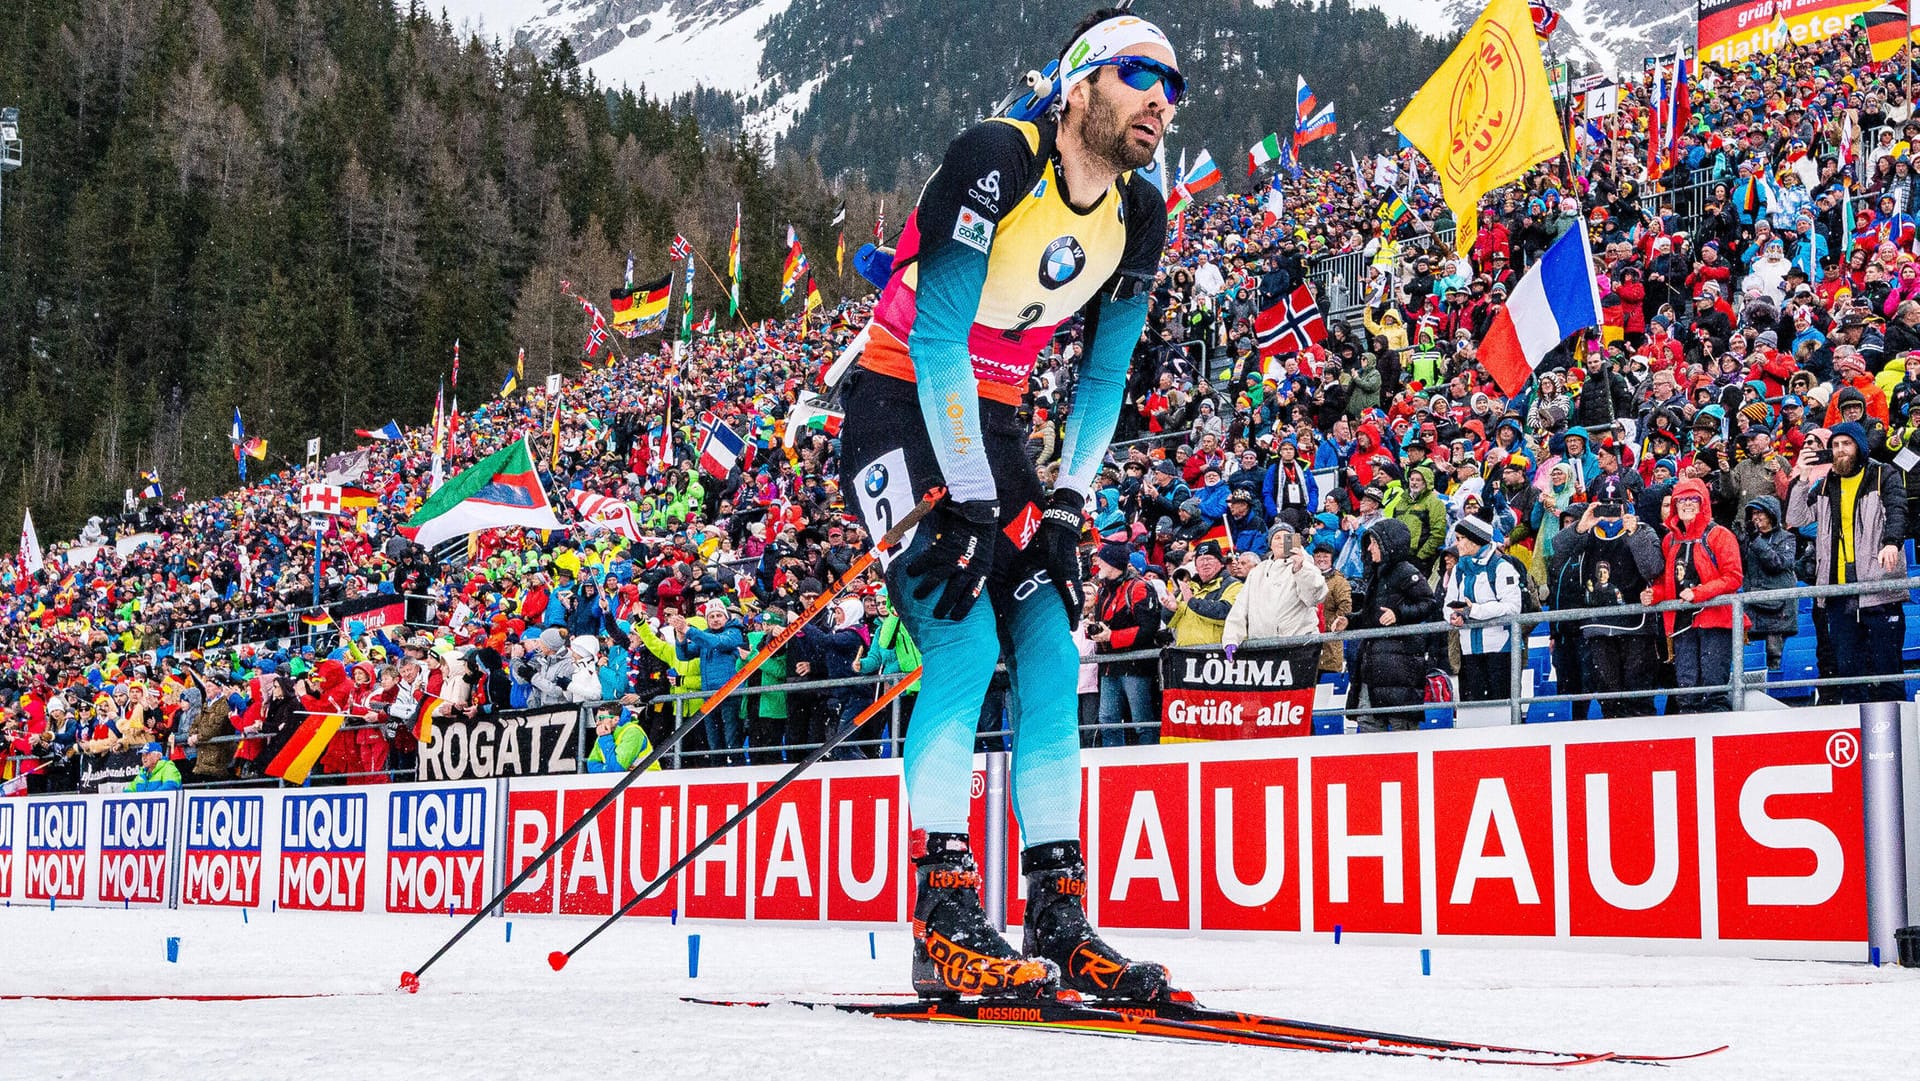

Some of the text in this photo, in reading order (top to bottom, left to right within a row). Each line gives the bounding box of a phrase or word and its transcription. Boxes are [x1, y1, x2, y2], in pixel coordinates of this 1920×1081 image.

[1594, 91, 1607, 111] 4
[968, 188, 999, 214] odlo
[1000, 302, 1046, 343] 2
[945, 392, 974, 455] somfy
[875, 497, 903, 558] 2
[1183, 653, 1294, 686] LÖHMA
[1168, 699, 1304, 726] Grüßt alle
[418, 710, 578, 781] ROGÄTZ
[29, 805, 85, 850] LIQUI
[103, 801, 167, 850] LIQUI
[190, 799, 261, 850] LIQUI
[284, 797, 363, 851] LIQUI
[393, 791, 481, 852] LIQUI
[1018, 764, 1845, 911] AUHAUS
[512, 798, 888, 902] BAUHAU
[28, 853, 84, 897] MOLY
[102, 852, 165, 900] MOLY
[189, 854, 259, 903] MOLY
[283, 855, 364, 907] MOLY
[391, 856, 483, 910] MOLY
[978, 1006, 1044, 1022] ROSSIGNOL
